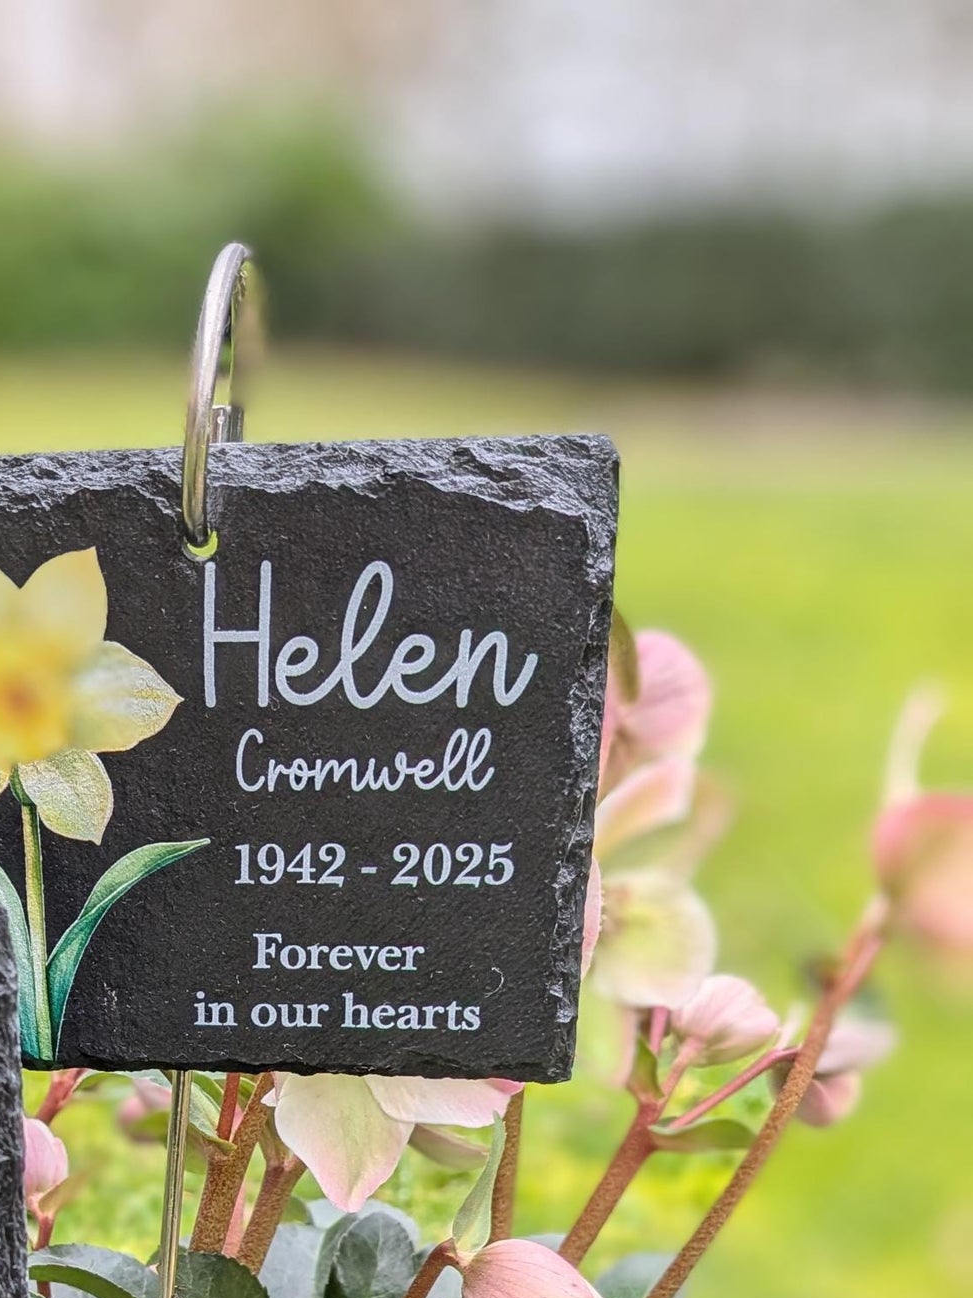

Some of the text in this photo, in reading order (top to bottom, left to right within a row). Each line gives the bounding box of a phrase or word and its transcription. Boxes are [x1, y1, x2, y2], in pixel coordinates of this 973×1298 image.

[203, 560, 539, 709] Helen
[236, 728, 494, 792] Cromwell
[235, 843, 345, 887] 1942
[391, 843, 515, 887] 2025
[253, 934, 424, 970] Forever
[194, 991, 480, 1030] in our hearts
